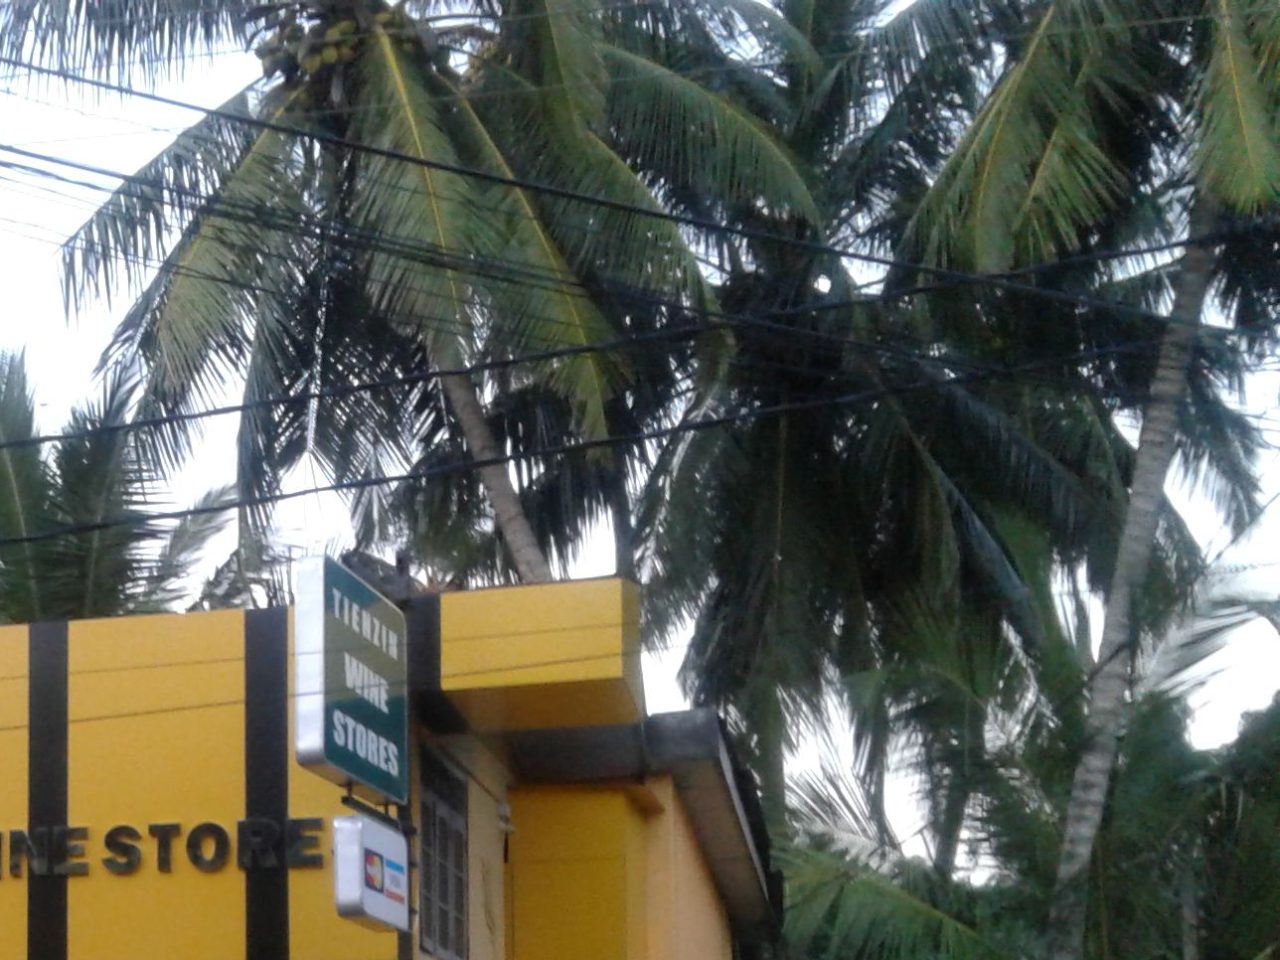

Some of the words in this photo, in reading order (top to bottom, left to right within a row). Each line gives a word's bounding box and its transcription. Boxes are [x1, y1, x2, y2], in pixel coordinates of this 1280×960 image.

[331, 587, 399, 661] TIENZIN
[343, 652, 390, 714] WINE
[331, 709, 400, 778] STORES
[102, 817, 325, 875] STORE
